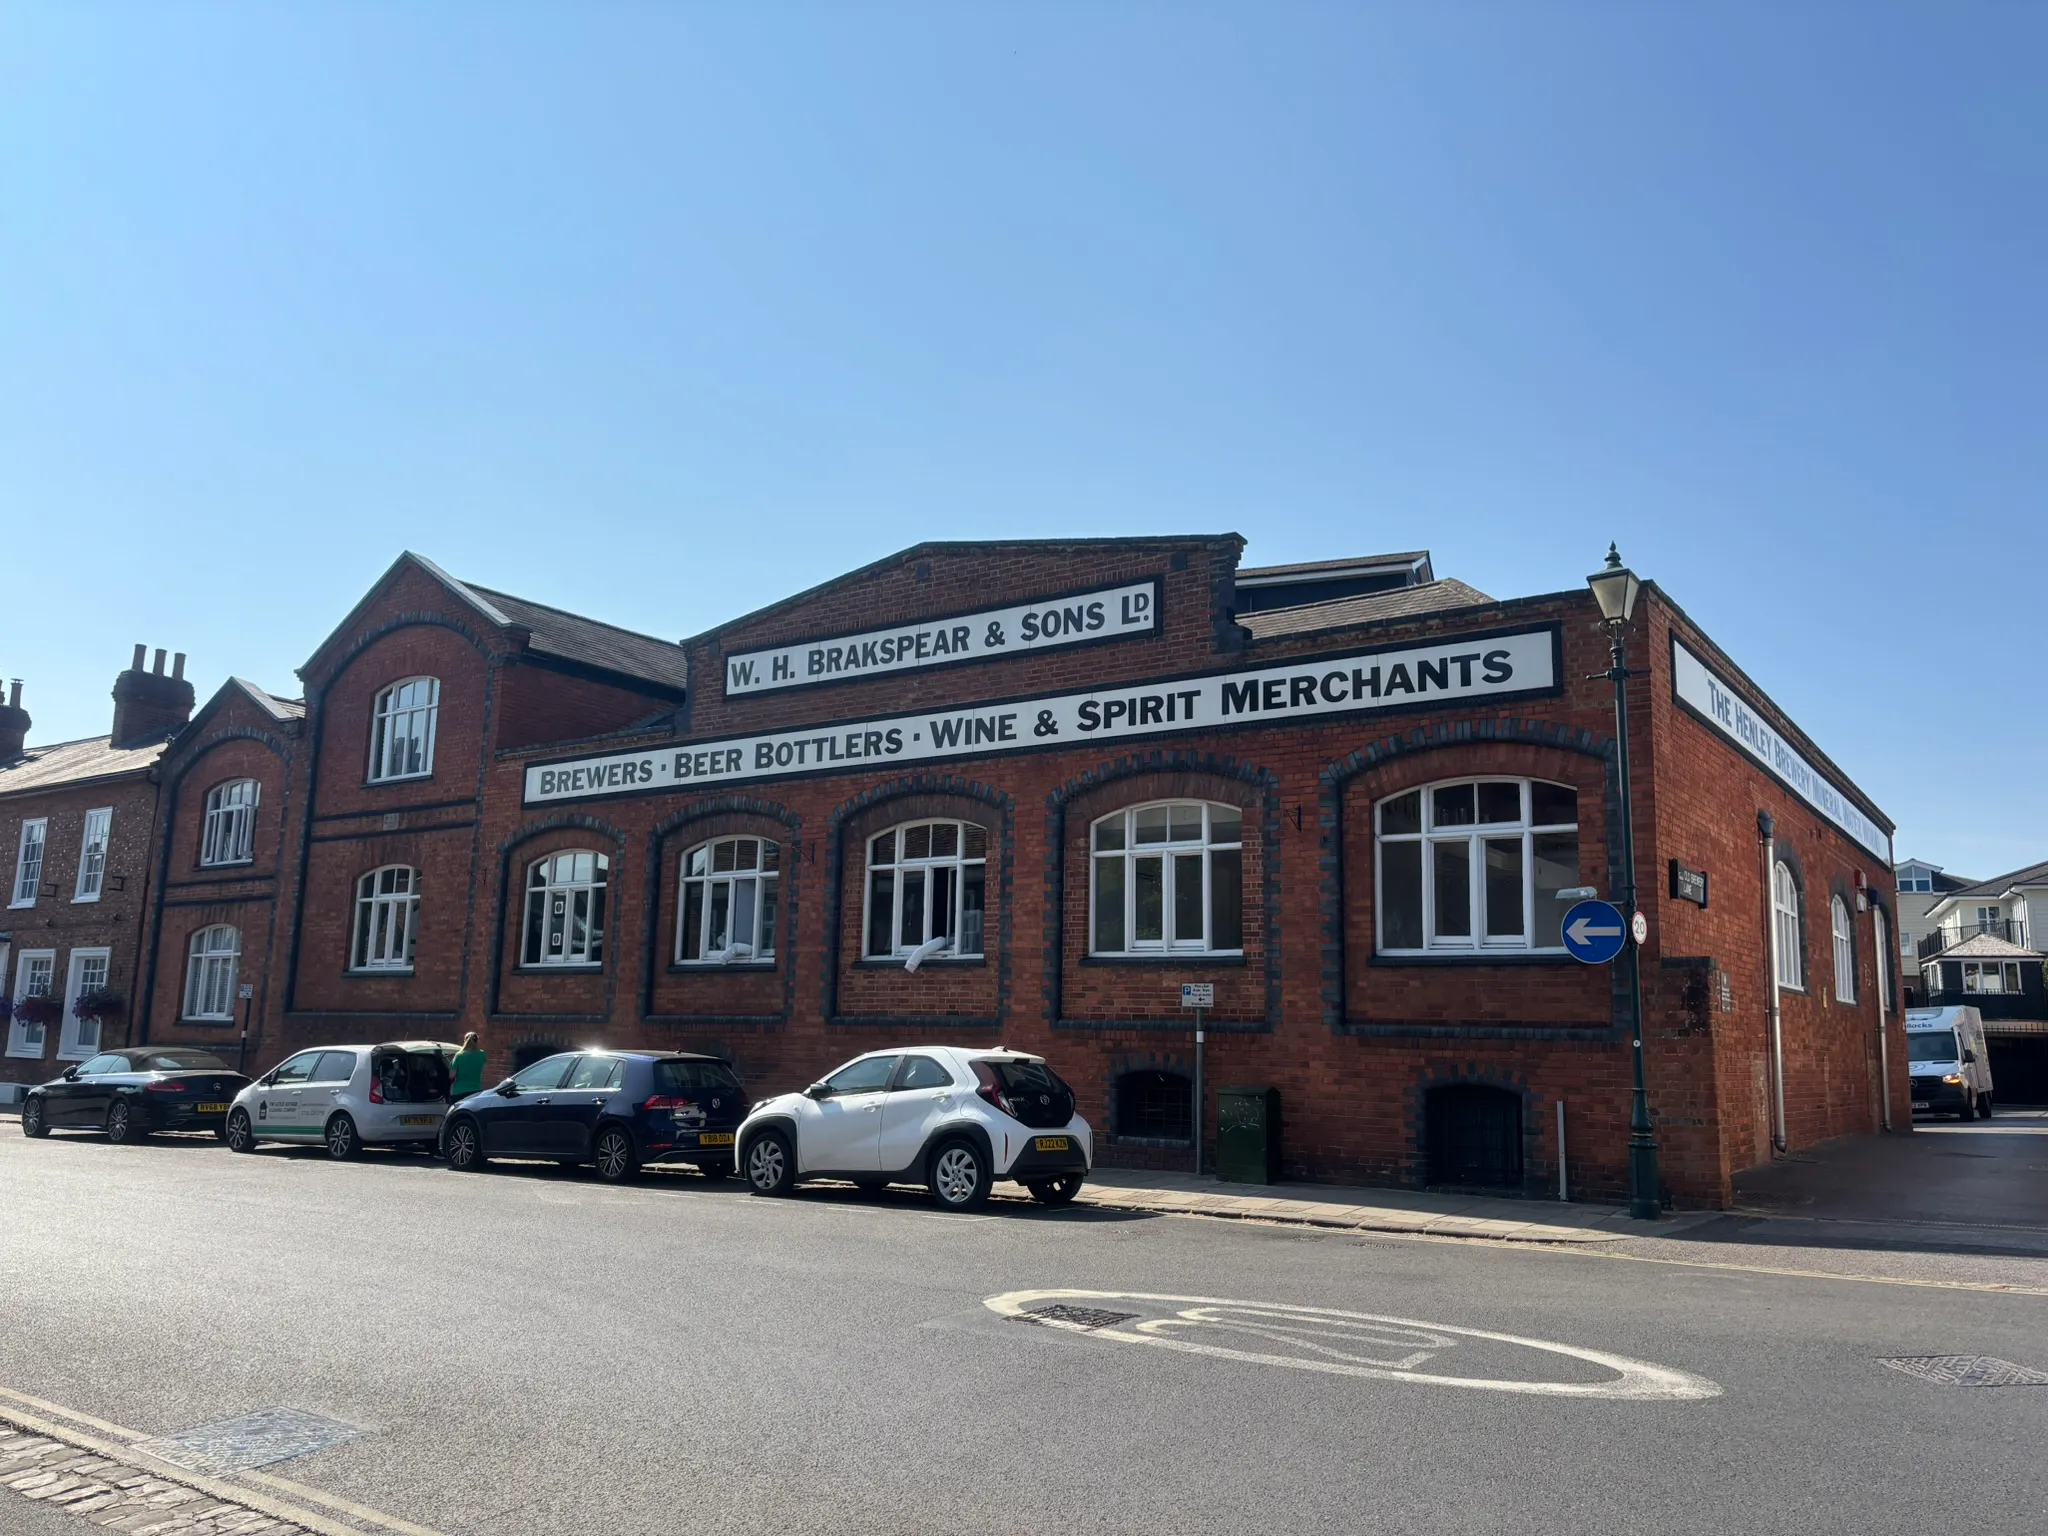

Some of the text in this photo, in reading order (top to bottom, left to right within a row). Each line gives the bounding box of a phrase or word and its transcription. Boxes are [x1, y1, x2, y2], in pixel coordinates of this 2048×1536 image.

[731, 660, 760, 687] W.
[772, 655, 795, 681] H.
[808, 626, 970, 675] BRAKSPEAR
[984, 621, 1006, 647] &
[1021, 602, 1105, 642] SONS
[540, 650, 1513, 794] BREWERS BEER BOTTLERS WINE & SPIRIT MERCHANTS
[1708, 679, 1732, 728] THE
[1735, 703, 1772, 762] HENLEY
[1774, 738, 1810, 795] BREWERY
[1635, 920, 1645, 935] 20
